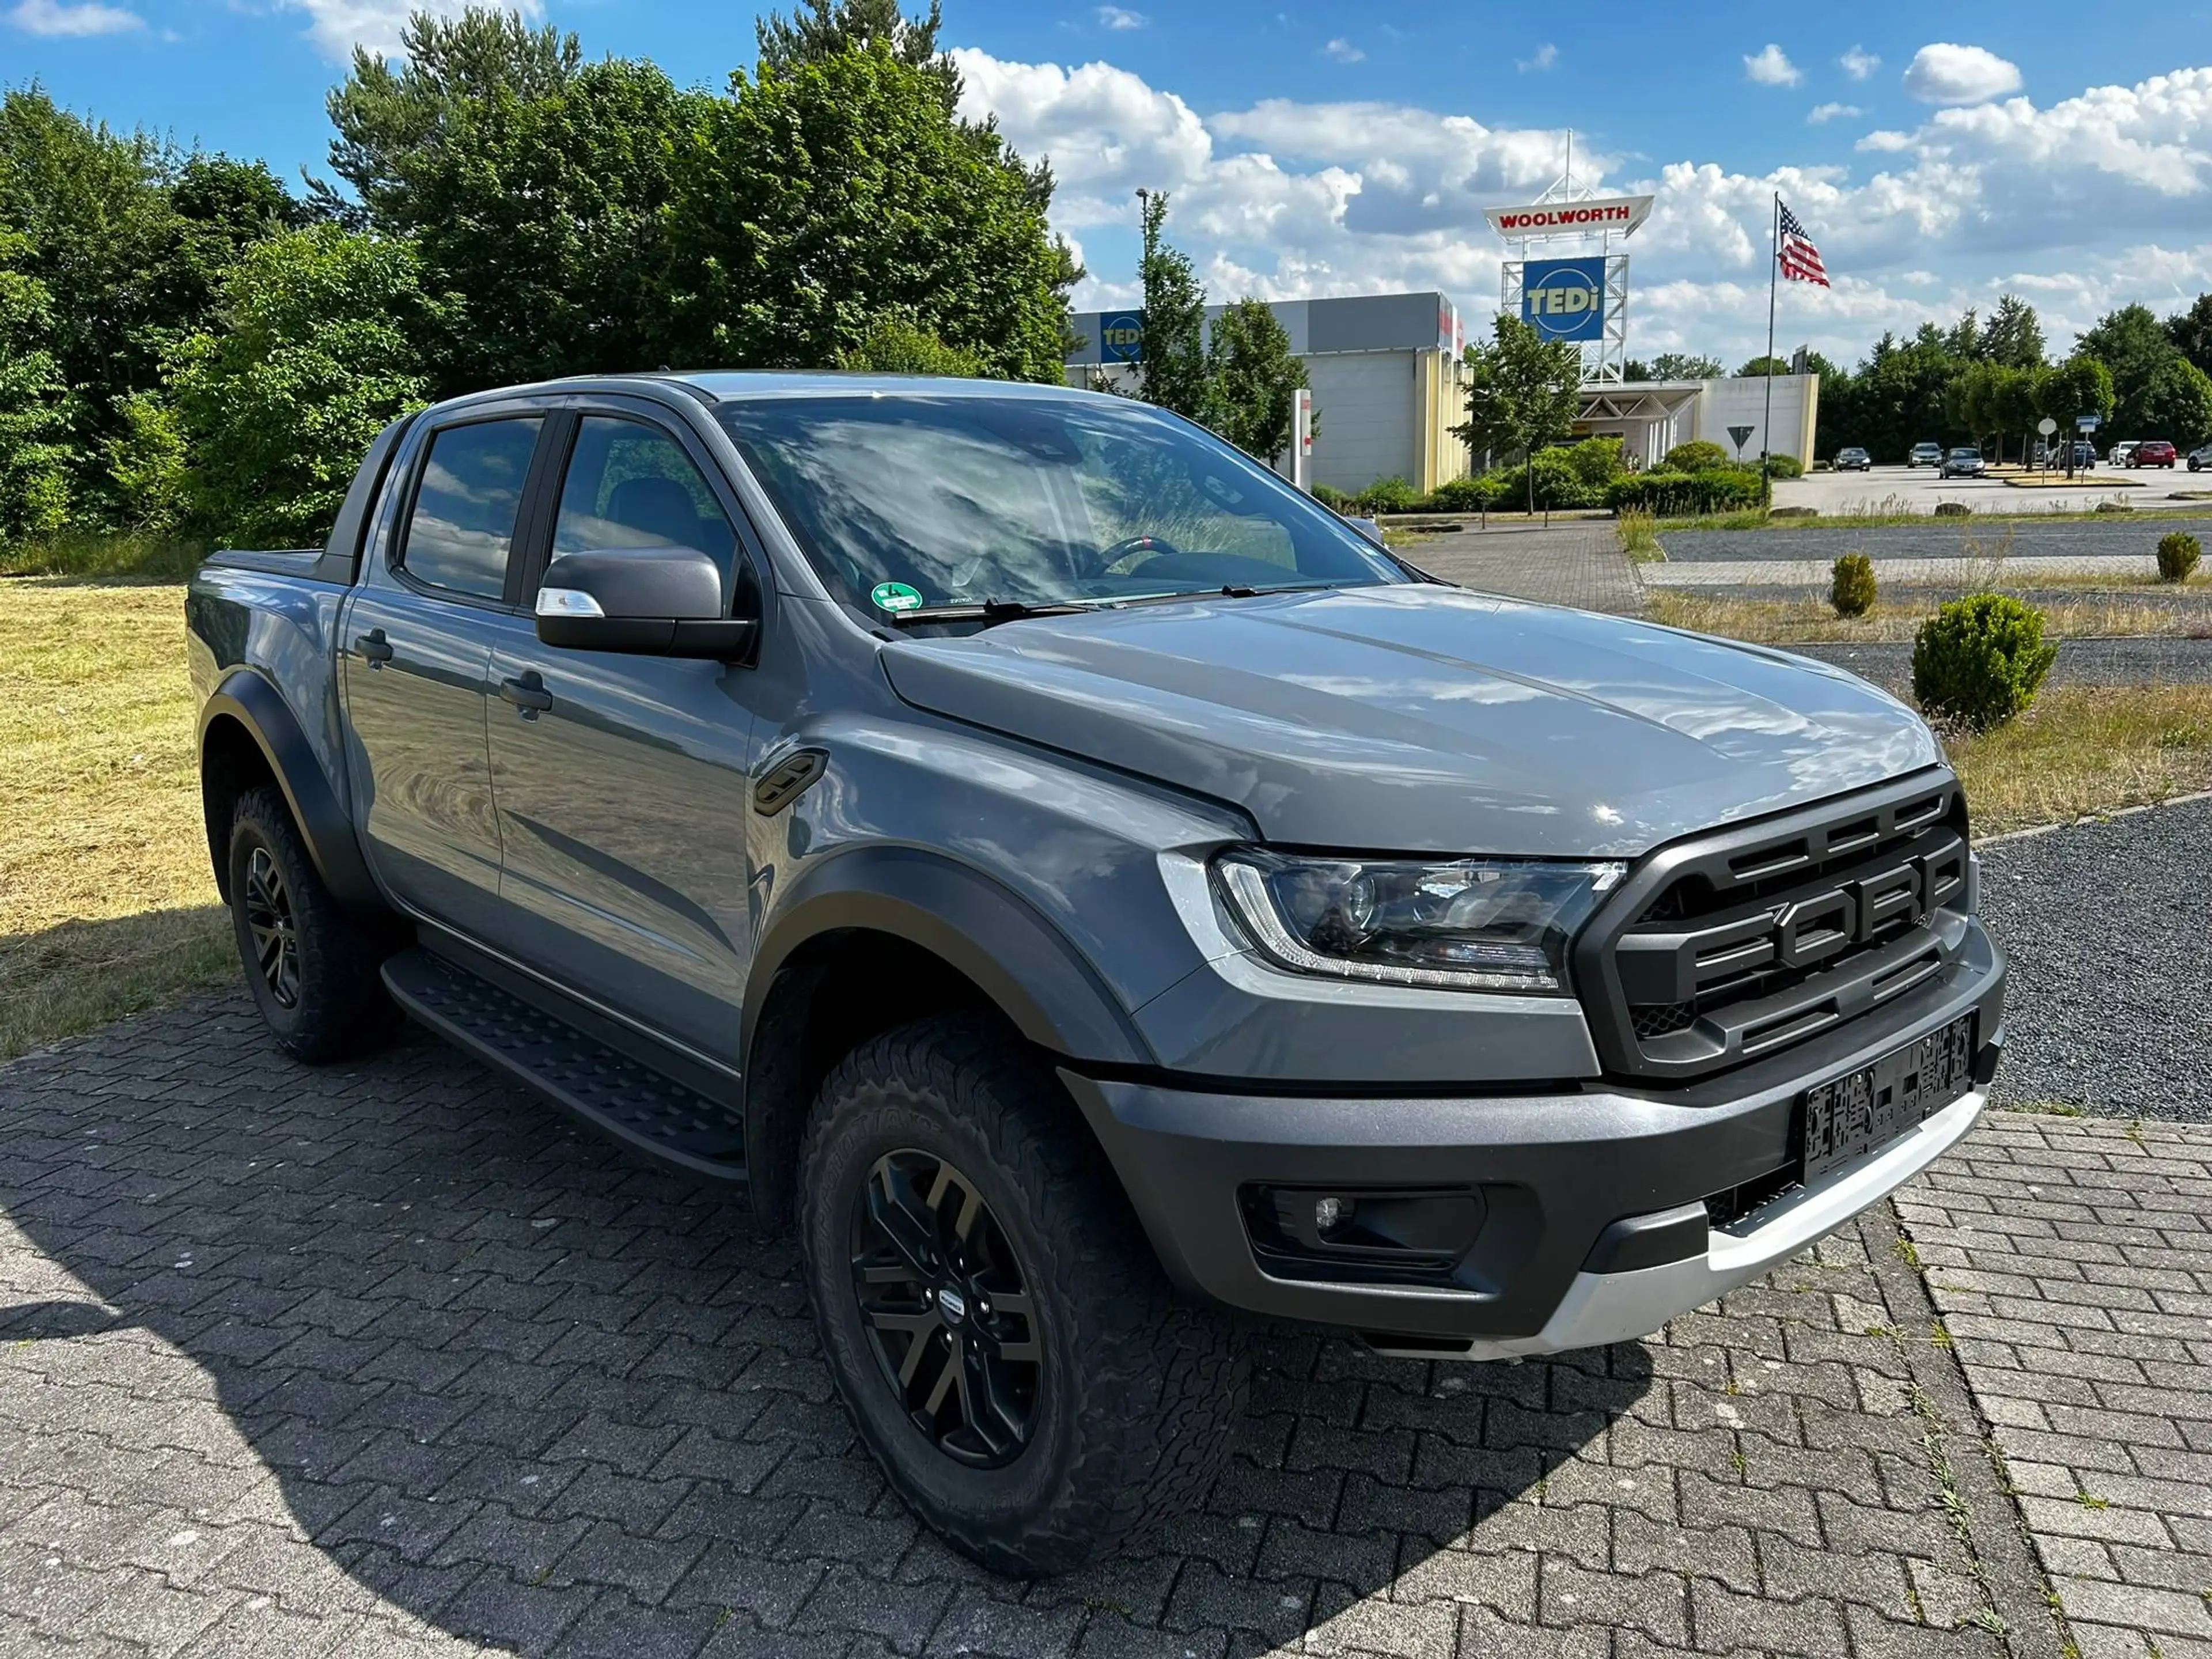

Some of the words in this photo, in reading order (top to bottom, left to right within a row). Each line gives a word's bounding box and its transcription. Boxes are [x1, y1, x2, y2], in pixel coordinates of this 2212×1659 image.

[1499, 206, 1630, 228] WOOLWORTH
[1527, 286, 1599, 315] TEDi
[888, 584, 901, 597] 4
[1673, 835, 1966, 1005] FORD
